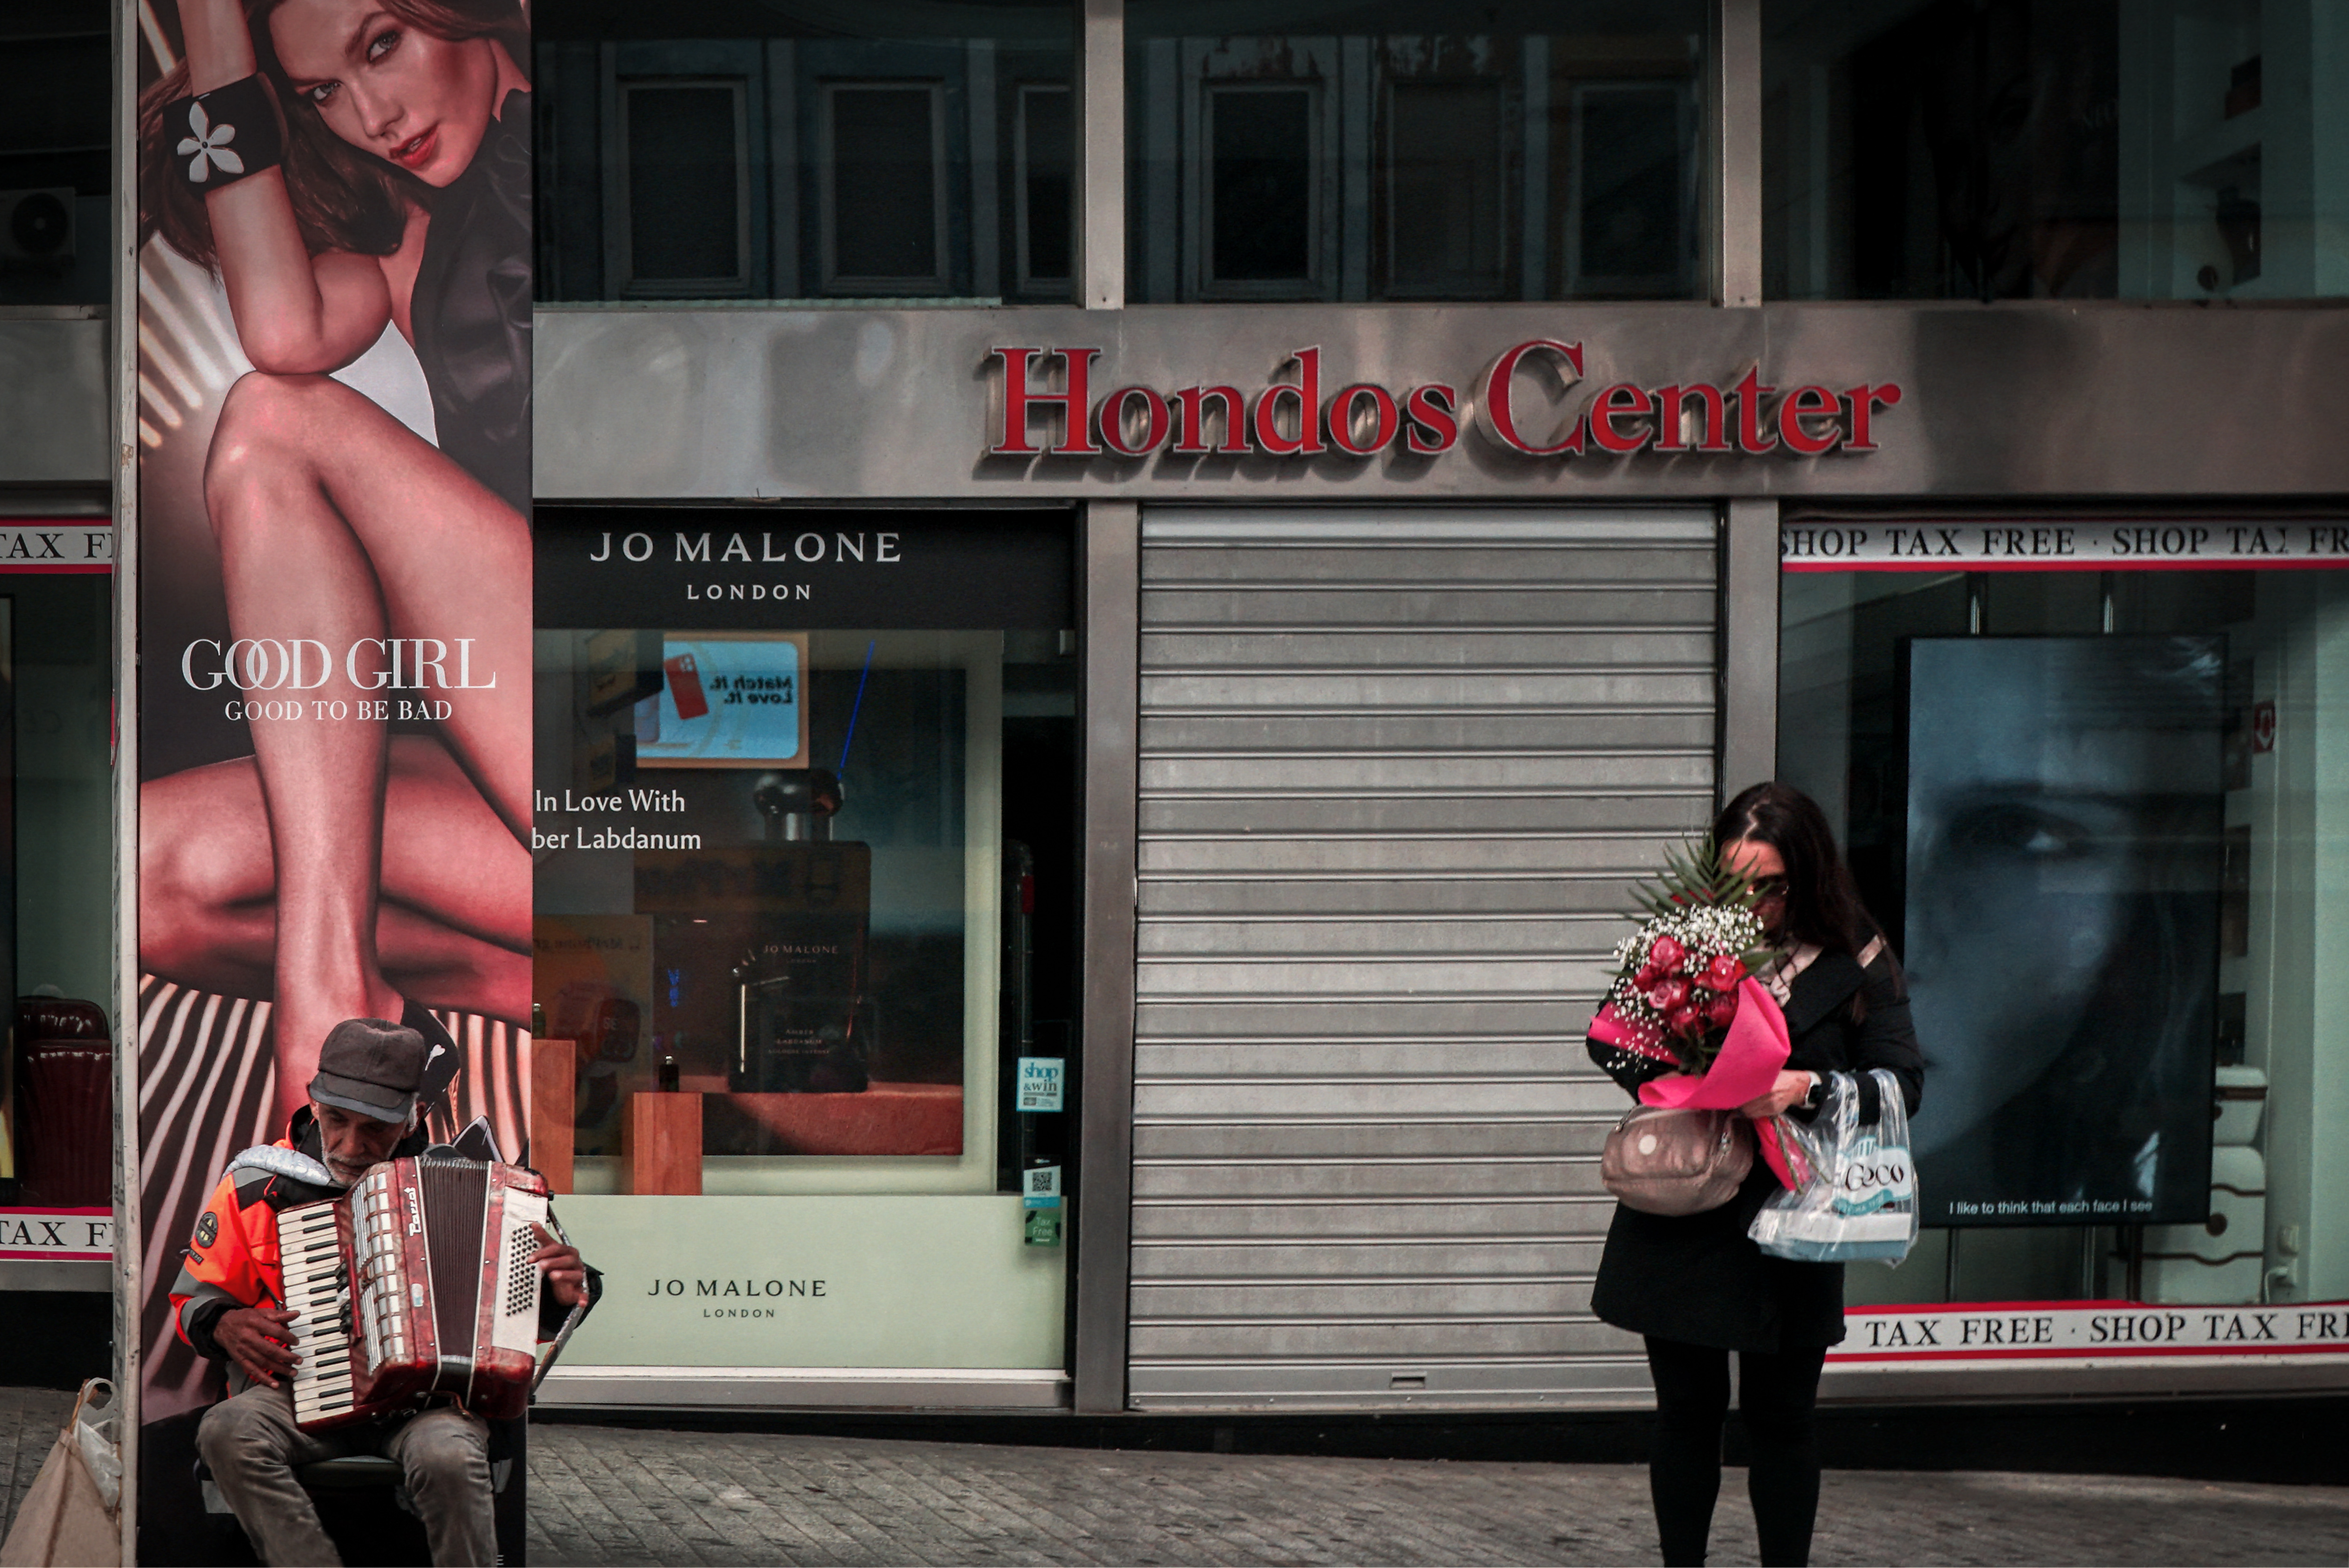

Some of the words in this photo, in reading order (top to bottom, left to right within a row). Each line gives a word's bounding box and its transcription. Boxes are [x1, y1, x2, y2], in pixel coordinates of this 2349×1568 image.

[990, 345, 1457, 455] Hondos
[1483, 339, 1902, 457] Center
[83, 533, 112, 559] F
[590, 532, 653, 563] JO
[674, 532, 901, 563] MALONE
[1885, 528, 1962, 556] TAX
[1980, 528, 2075, 555] FREE
[2112, 527, 2209, 555] SHOP
[687, 584, 811, 600] LONDON
[182, 638, 332, 691] GOOD
[346, 638, 496, 690] GIRL
[225, 700, 303, 721] GOOD
[312, 700, 347, 721] TO
[357, 701, 388, 720] BE
[397, 700, 452, 720] BAD
[536, 789, 557, 812] In
[565, 789, 622, 812] Love
[628, 789, 685, 812] With
[532, 827, 570, 849] ber
[577, 827, 701, 849] Labdanum
[1024, 1062, 1059, 1082] shop
[1949, 1202, 1954, 1214] I
[1957, 1201, 1979, 1214] like
[1981, 1202, 1995, 1214] to
[1997, 1201, 2028, 1214] think
[2032, 1201, 2056, 1213] that
[2059, 1200, 2089, 1213] each
[2093, 1199, 2120, 1212] face
[2123, 1199, 2127, 1212] I
[2131, 1202, 2153, 1212] see
[85, 1222, 113, 1247] F
[648, 1279, 684, 1296] JO
[697, 1279, 826, 1297] MALONE
[703, 1309, 776, 1318] LONDON
[1866, 1319, 1941, 1347] TAX
[1960, 1317, 2053, 1345] FREE
[2090, 1314, 2186, 1342] SHOP
[2203, 1313, 2278, 1341] TAX
